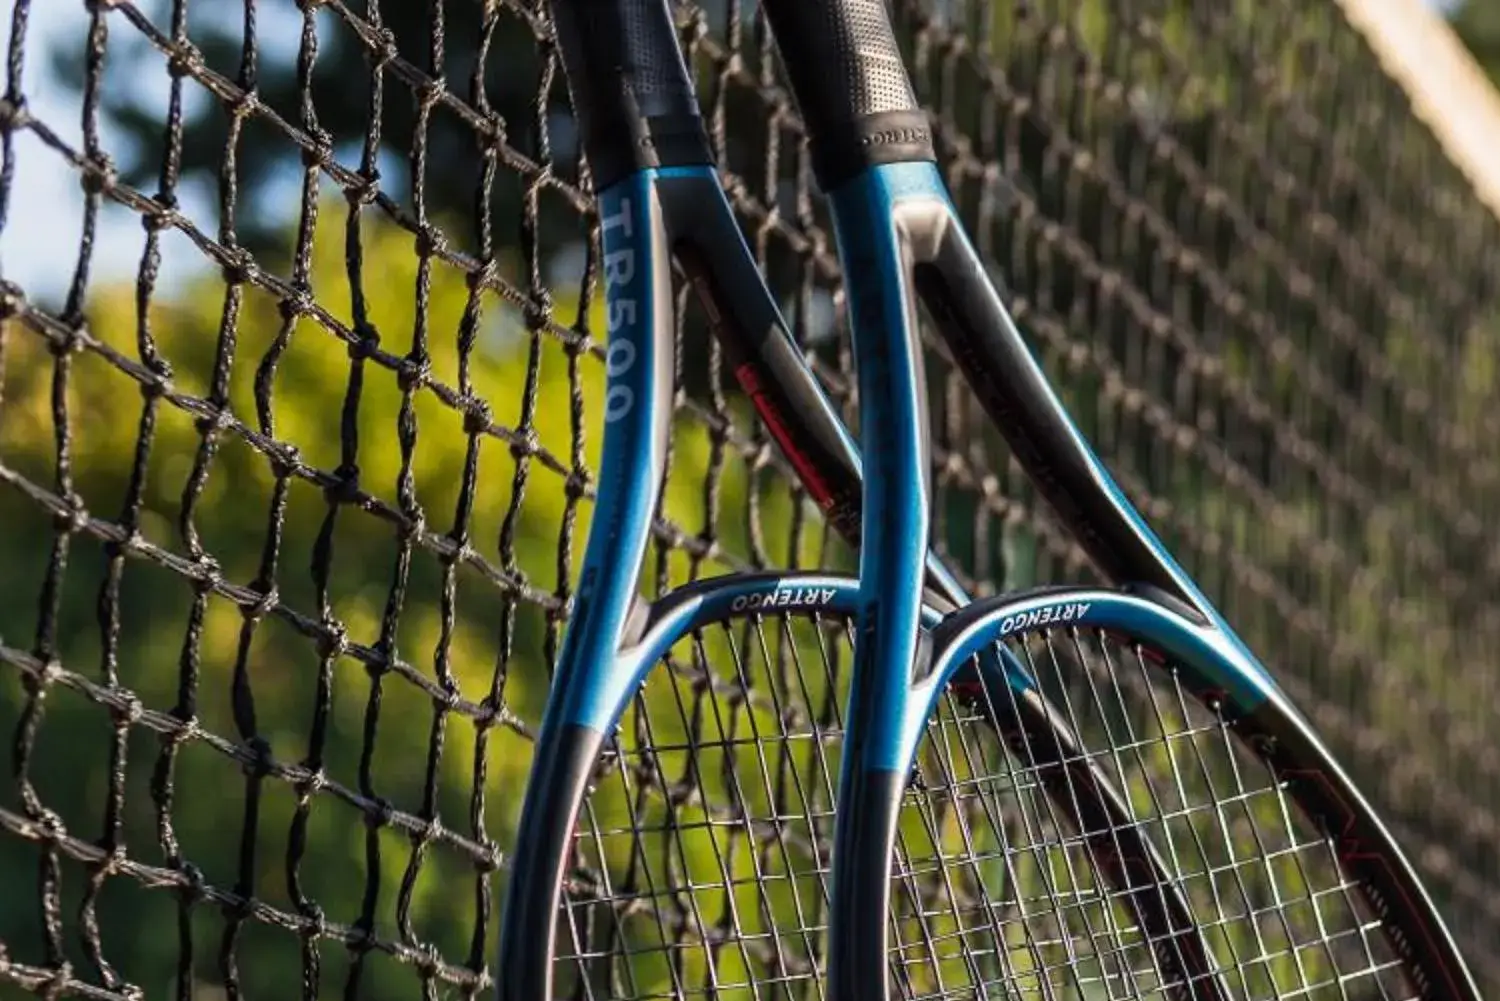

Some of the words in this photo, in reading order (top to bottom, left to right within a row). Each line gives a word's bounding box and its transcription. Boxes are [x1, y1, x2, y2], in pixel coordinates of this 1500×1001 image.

[602, 198, 637, 423] TR500
[731, 589, 836, 611] ARTENGO
[1000, 603, 1091, 635] ARTENGO
